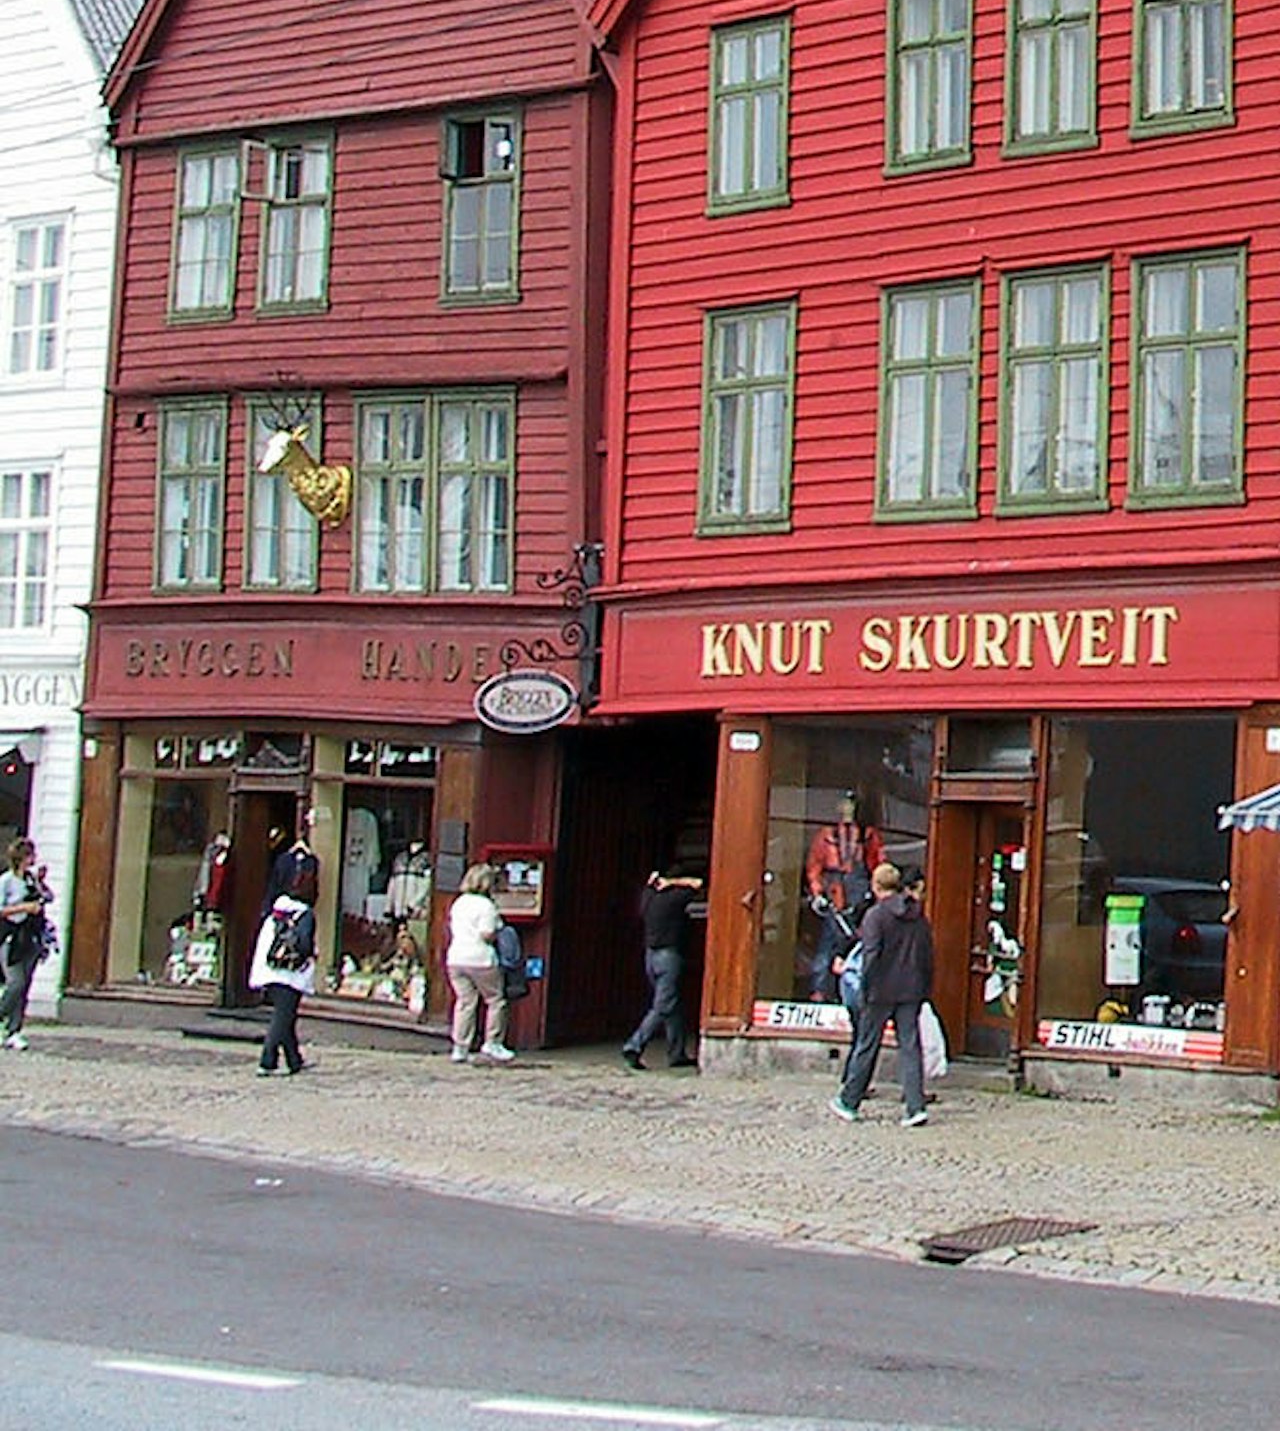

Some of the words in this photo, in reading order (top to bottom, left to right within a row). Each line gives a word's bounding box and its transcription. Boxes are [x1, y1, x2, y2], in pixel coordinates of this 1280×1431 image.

[701, 619, 833, 678] KNUT
[858, 606, 1179, 672] SKURTVEIT
[126, 638, 295, 679] BRYGGEN
[361, 639, 512, 684] HANDE
[774, 1004, 825, 1027] STIHL
[1055, 1024, 1116, 1048] STIHL
